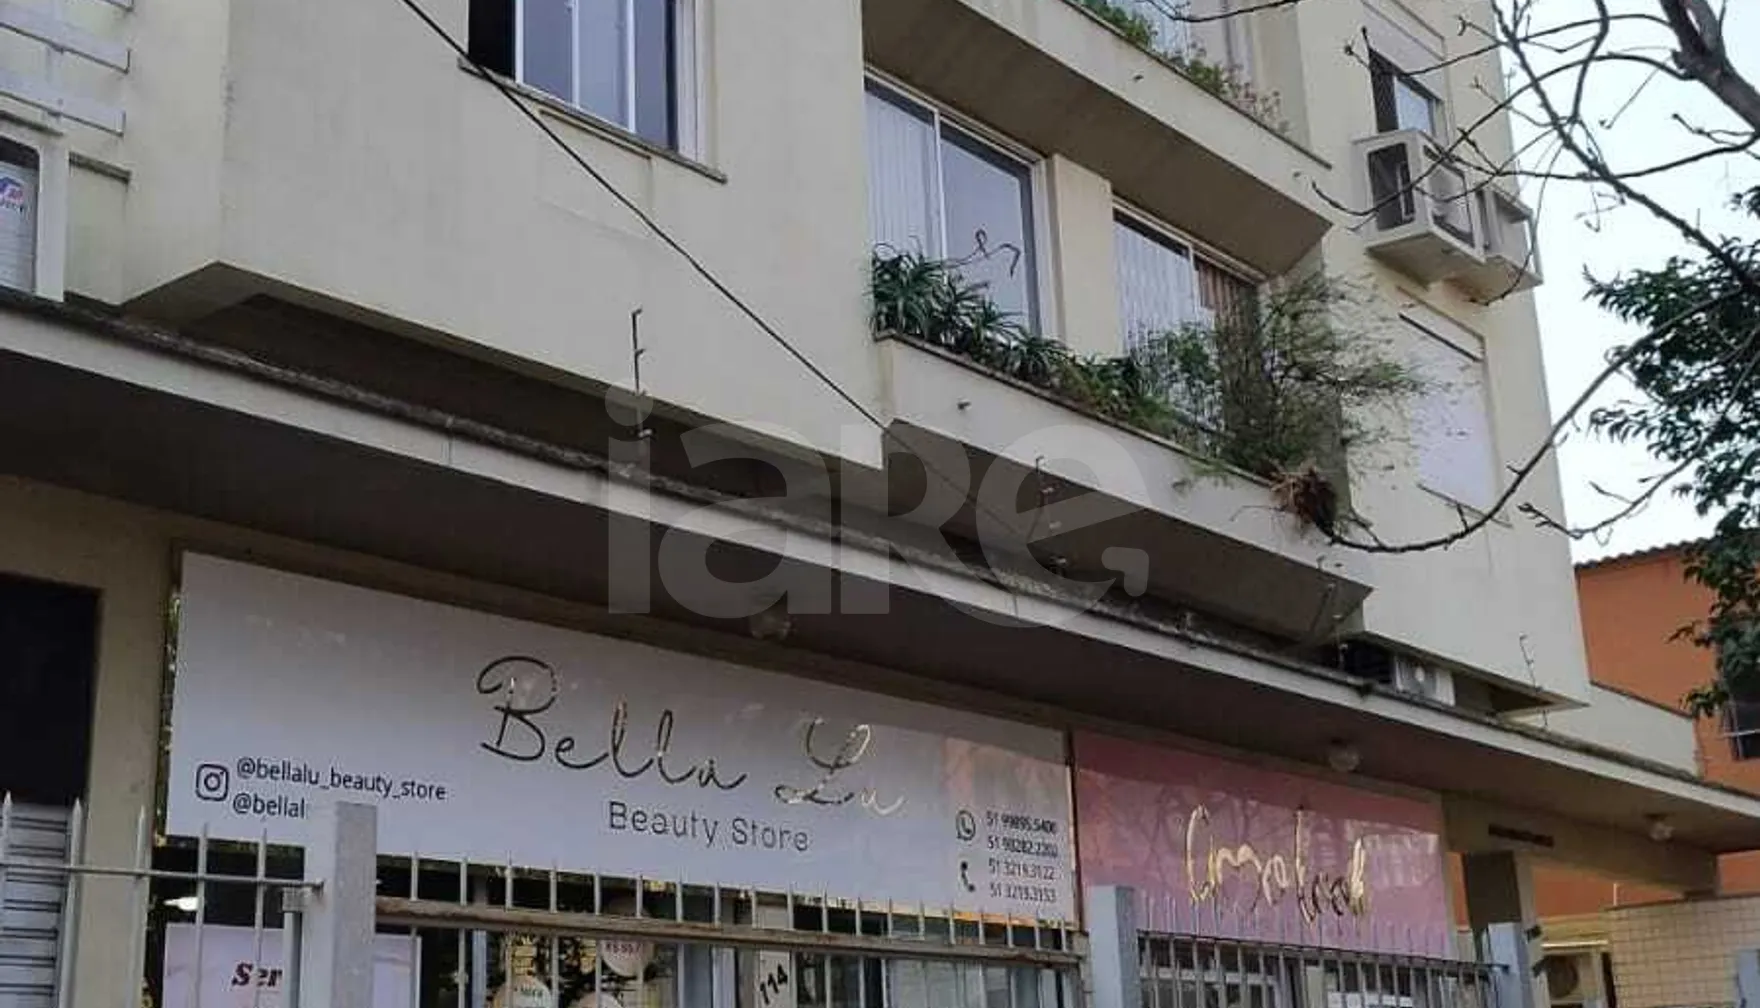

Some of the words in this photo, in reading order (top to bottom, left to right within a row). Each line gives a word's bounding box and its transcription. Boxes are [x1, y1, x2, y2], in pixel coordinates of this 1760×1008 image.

[476, 655, 748, 790] Bella
[773, 716, 907, 816] Lu
[236, 757, 448, 800] @bellalu_beauty_store
[608, 800, 720, 845] Beauty
[732, 818, 810, 852] Store
[986, 810, 999, 828] 51
[988, 835, 1000, 850] 51
[988, 858, 1001, 875] 51
[990, 881, 1002, 898] 51
